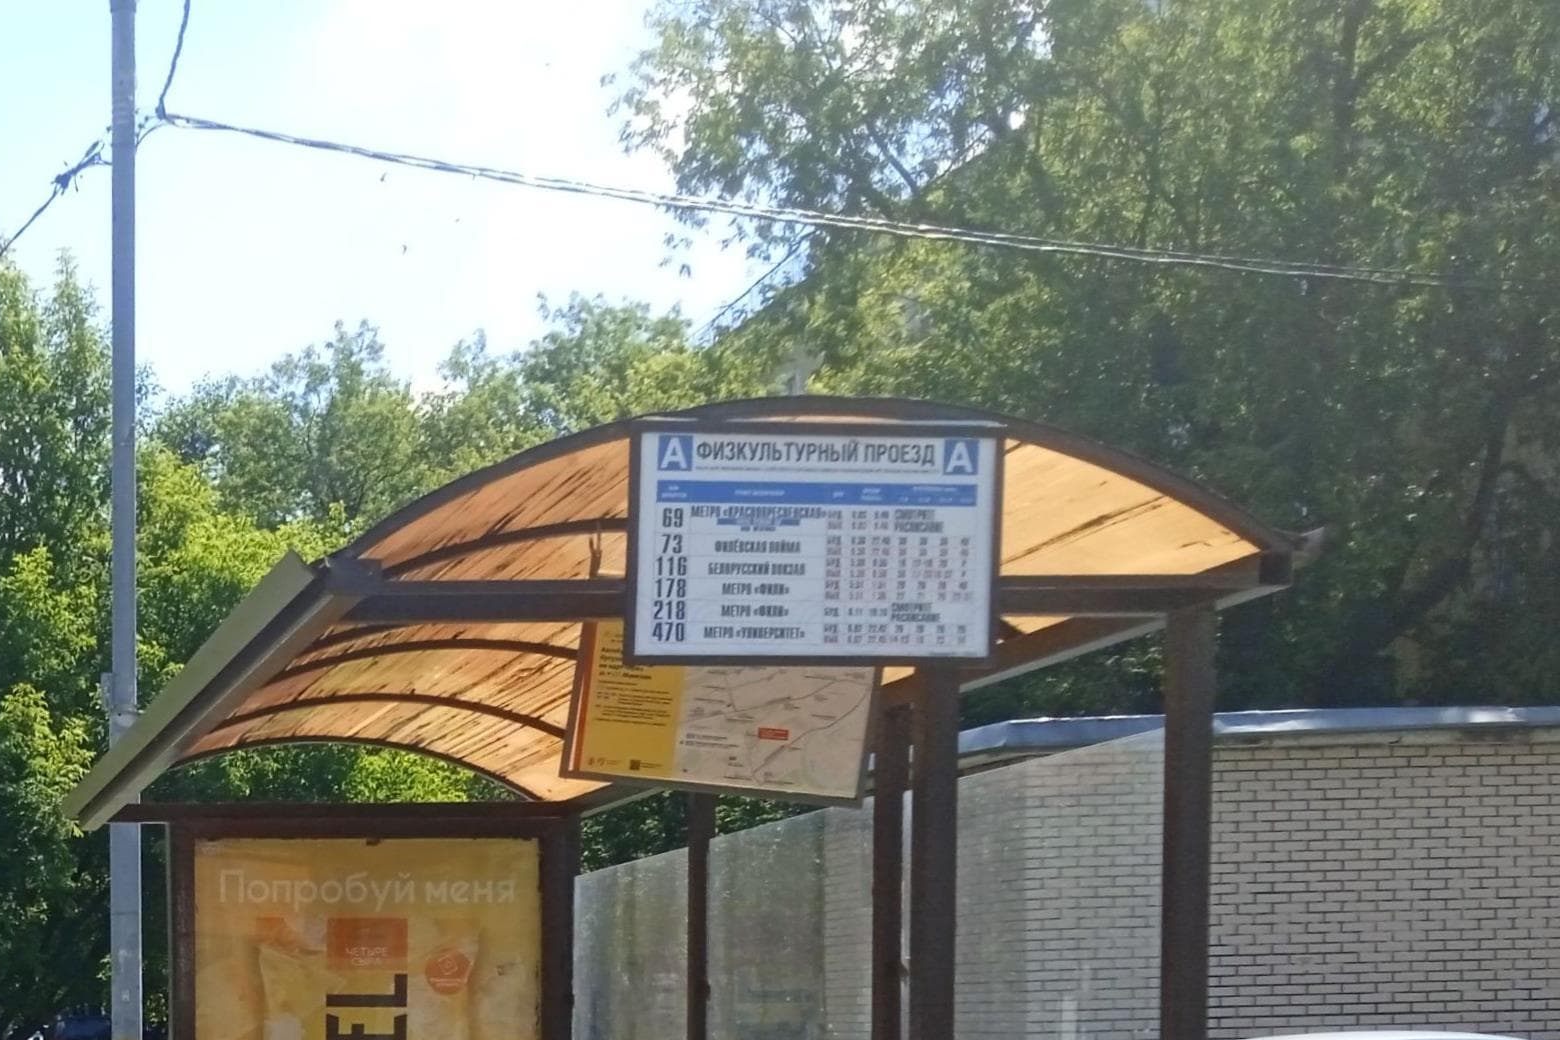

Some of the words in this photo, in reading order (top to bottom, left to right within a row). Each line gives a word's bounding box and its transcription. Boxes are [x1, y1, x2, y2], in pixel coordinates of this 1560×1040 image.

[696, 439, 859, 464] ФИЗКУЛЬТУРНЫЙ
[864, 443, 936, 467] ПРОЕЗД
[662, 507, 684, 528] 69
[691, 505, 721, 517] МЕТРО
[662, 534, 683, 554] 73
[656, 556, 687, 576] 116
[708, 561, 770, 575] БЕЛОРУССКИЙ
[771, 562, 806, 576] ВОКЗАЛ
[655, 578, 687, 598] 178
[722, 582, 752, 595] МЕТРО
[754, 582, 790, 595] «ФИЛИ»
[653, 600, 686, 620] 218
[720, 604, 751, 617] МЕТРО
[753, 604, 789, 617] «ФИЛИ»
[652, 622, 686, 642] 470
[703, 626, 734, 639] МЕТРО
[735, 626, 806, 640] «УНИВЕРСИТЕТ»
[219, 869, 416, 912] Попробуй
[425, 879, 517, 904] меня
